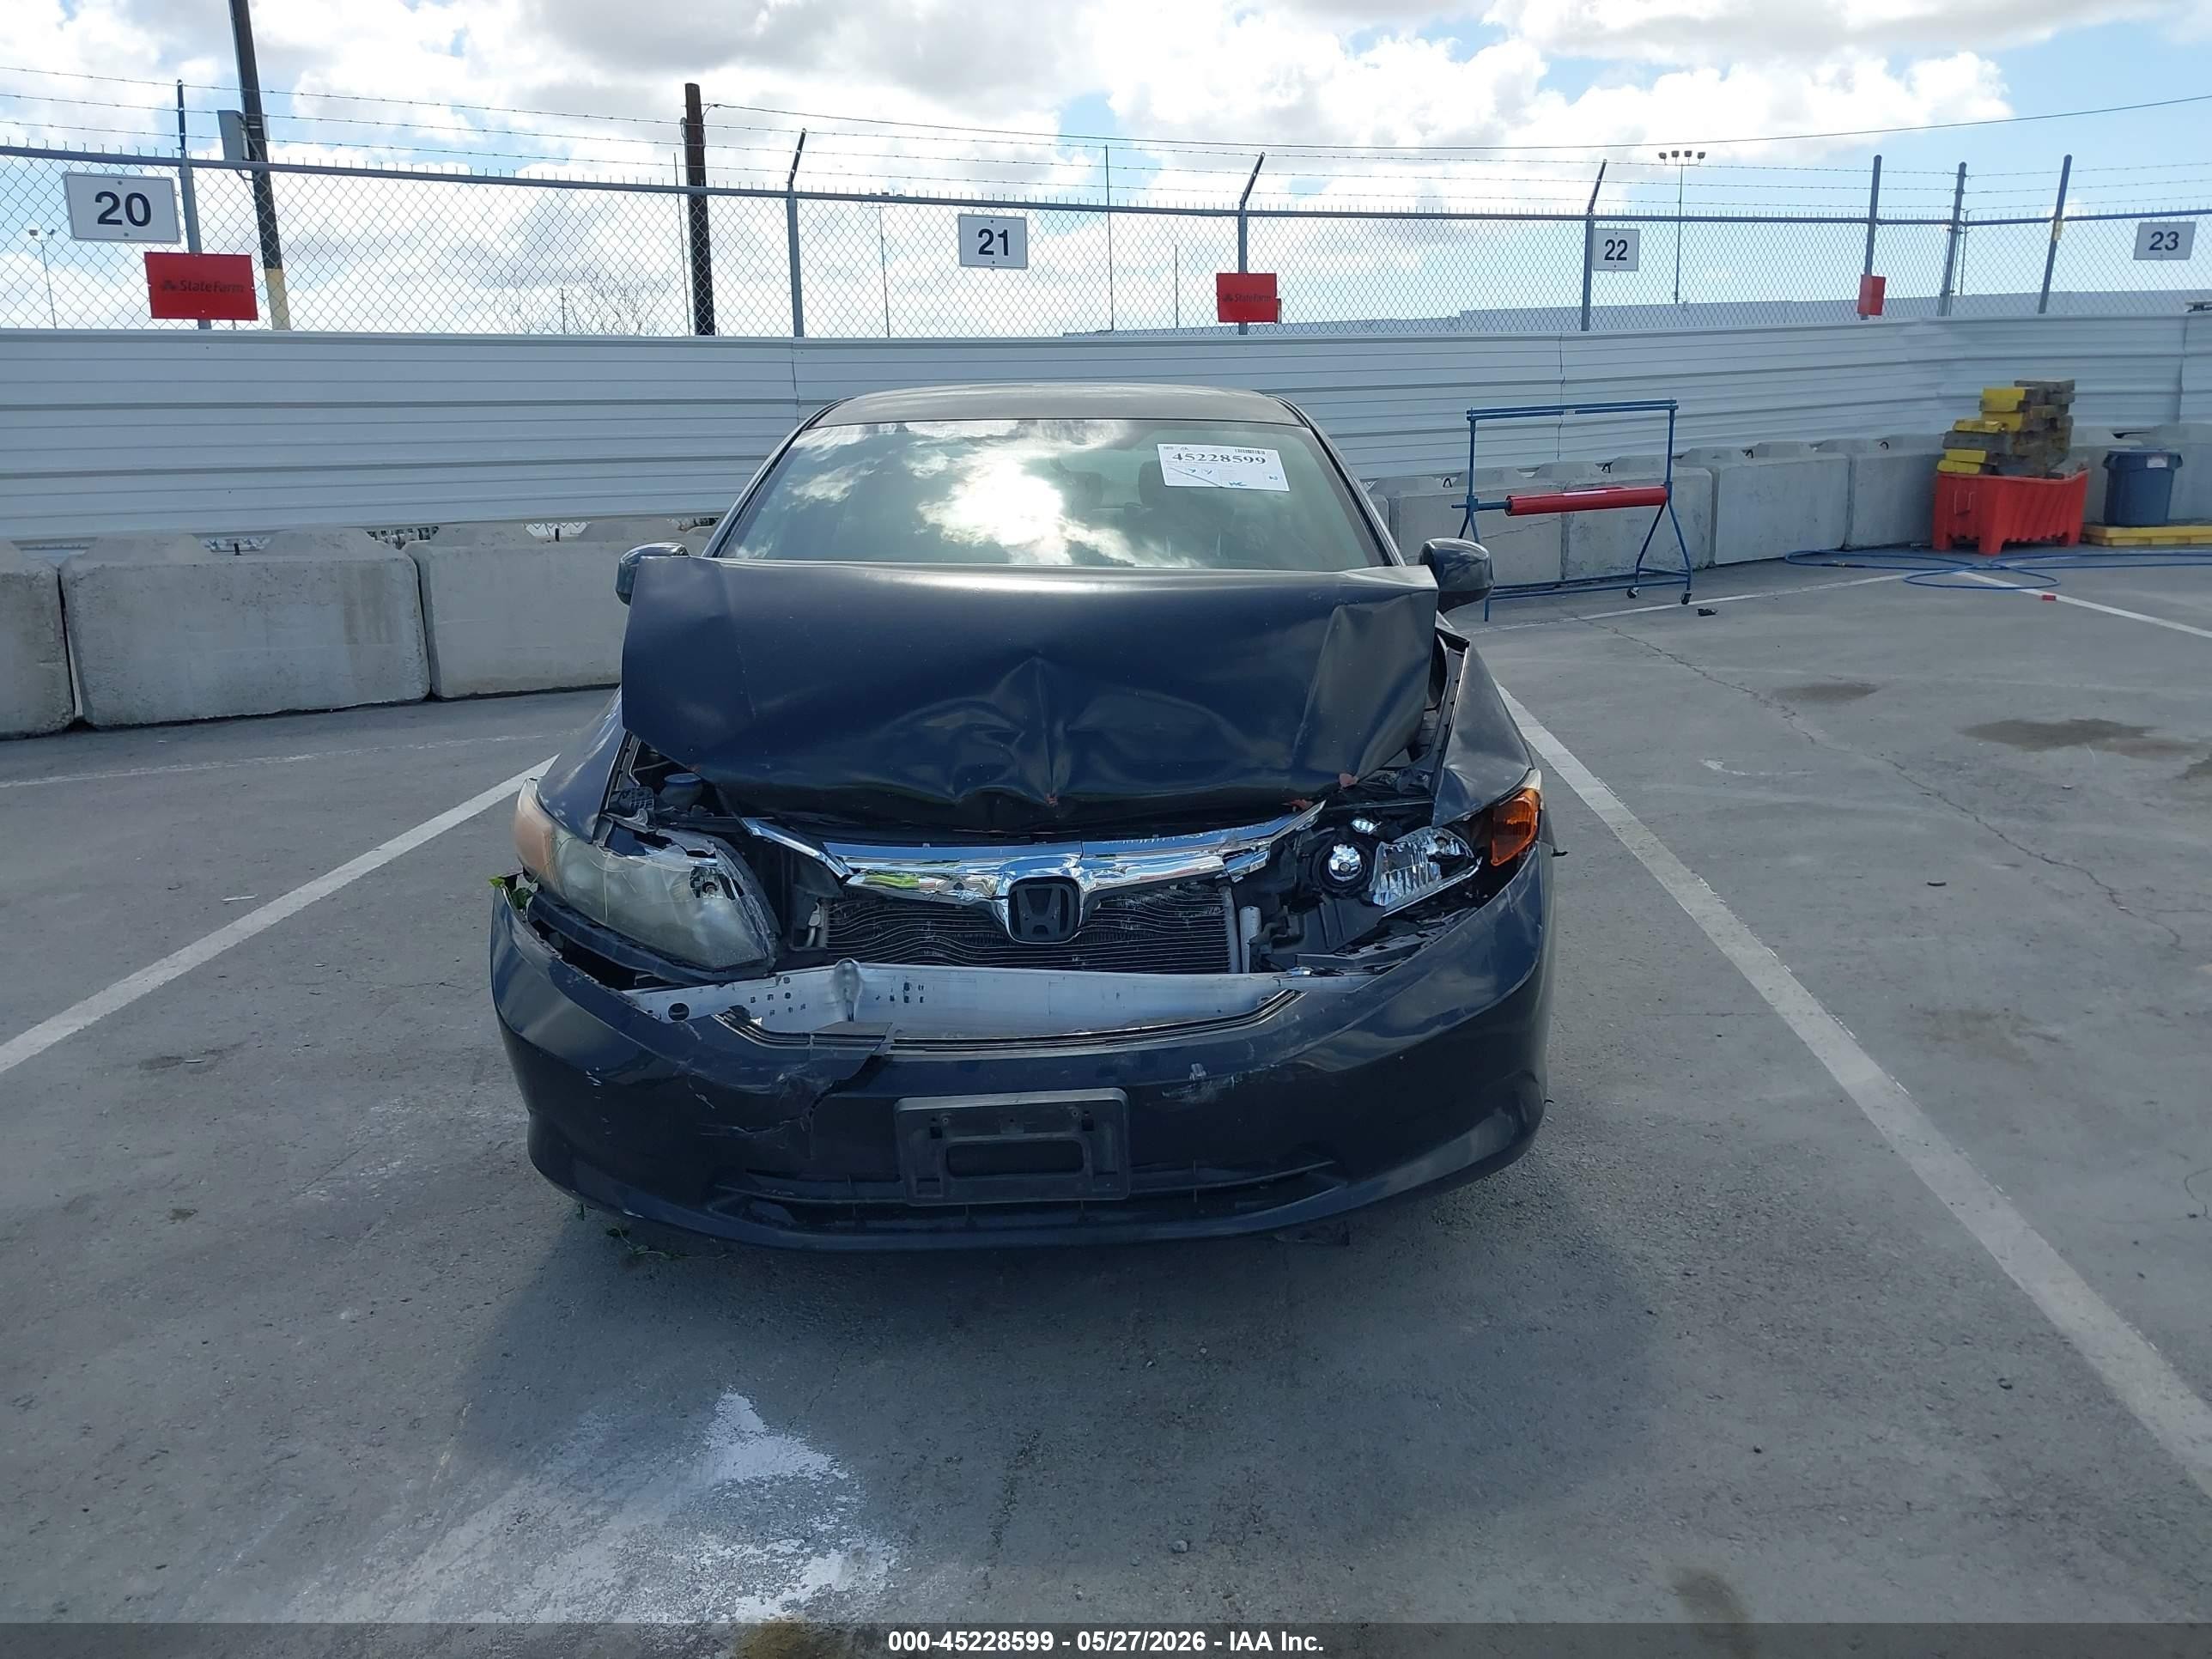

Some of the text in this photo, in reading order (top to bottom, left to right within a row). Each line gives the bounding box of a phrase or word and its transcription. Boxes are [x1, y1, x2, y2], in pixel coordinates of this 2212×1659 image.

[94, 191, 152, 227] 20
[977, 228, 1009, 256] 21
[1603, 239, 1628, 261] 22
[2148, 231, 2179, 251] 23
[1171, 453, 1267, 465] 45228599
